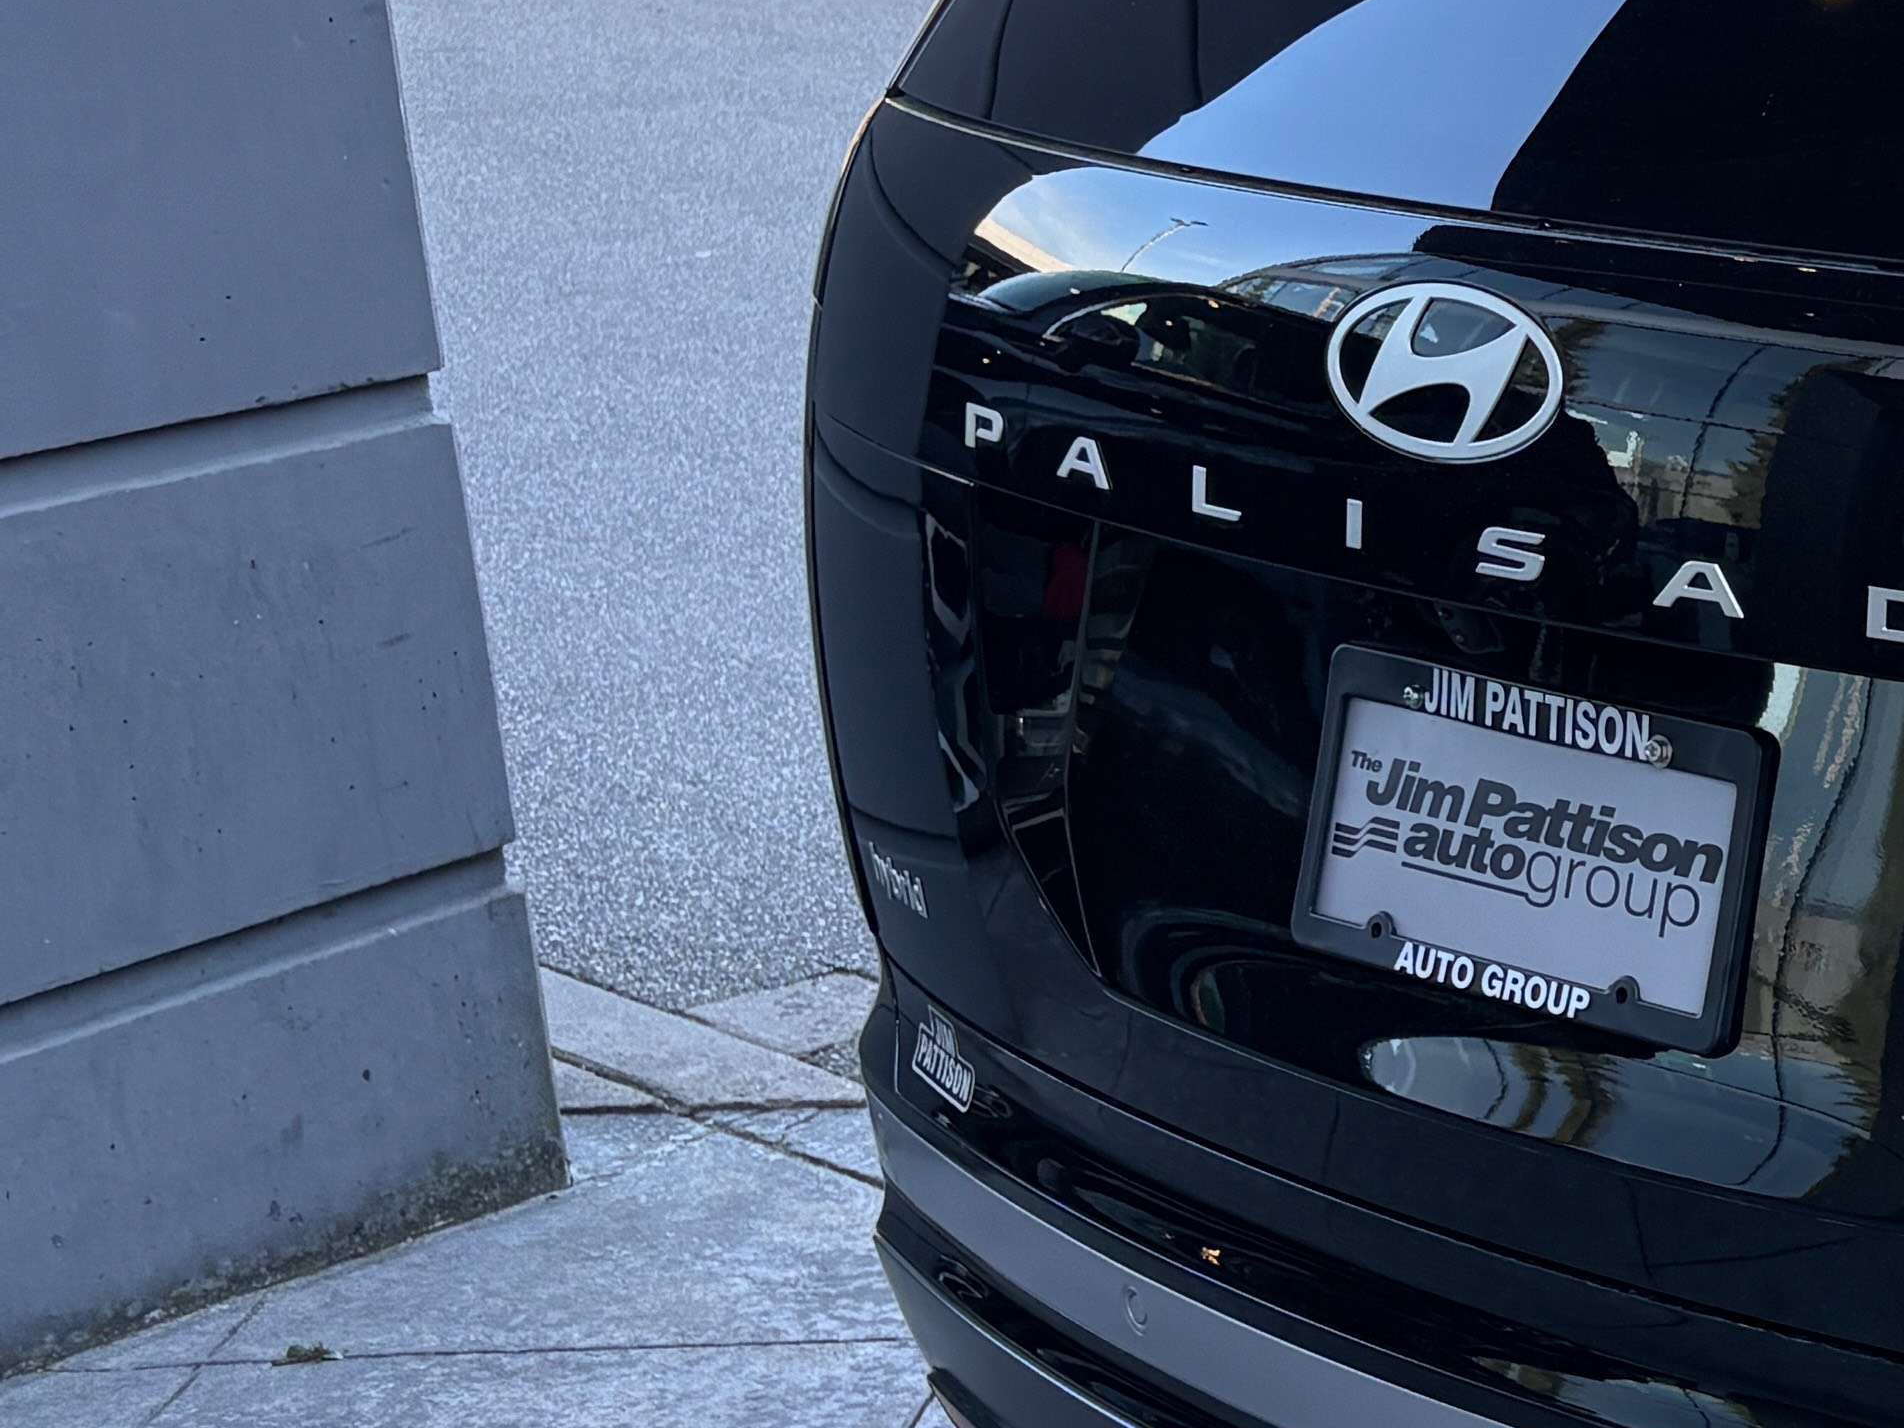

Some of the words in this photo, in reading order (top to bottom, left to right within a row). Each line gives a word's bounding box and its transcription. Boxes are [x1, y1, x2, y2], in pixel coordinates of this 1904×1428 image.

[1424, 668, 1476, 723] JIM
[1485, 682, 1650, 761] PATTISON
[1350, 749, 1383, 774] The
[1365, 757, 1466, 823] Jim
[1464, 777, 1725, 884] Pattison
[1394, 941, 1475, 990] AUTO
[1481, 964, 1591, 1019] GROUP
[917, 1032, 972, 1103] PATTISON
